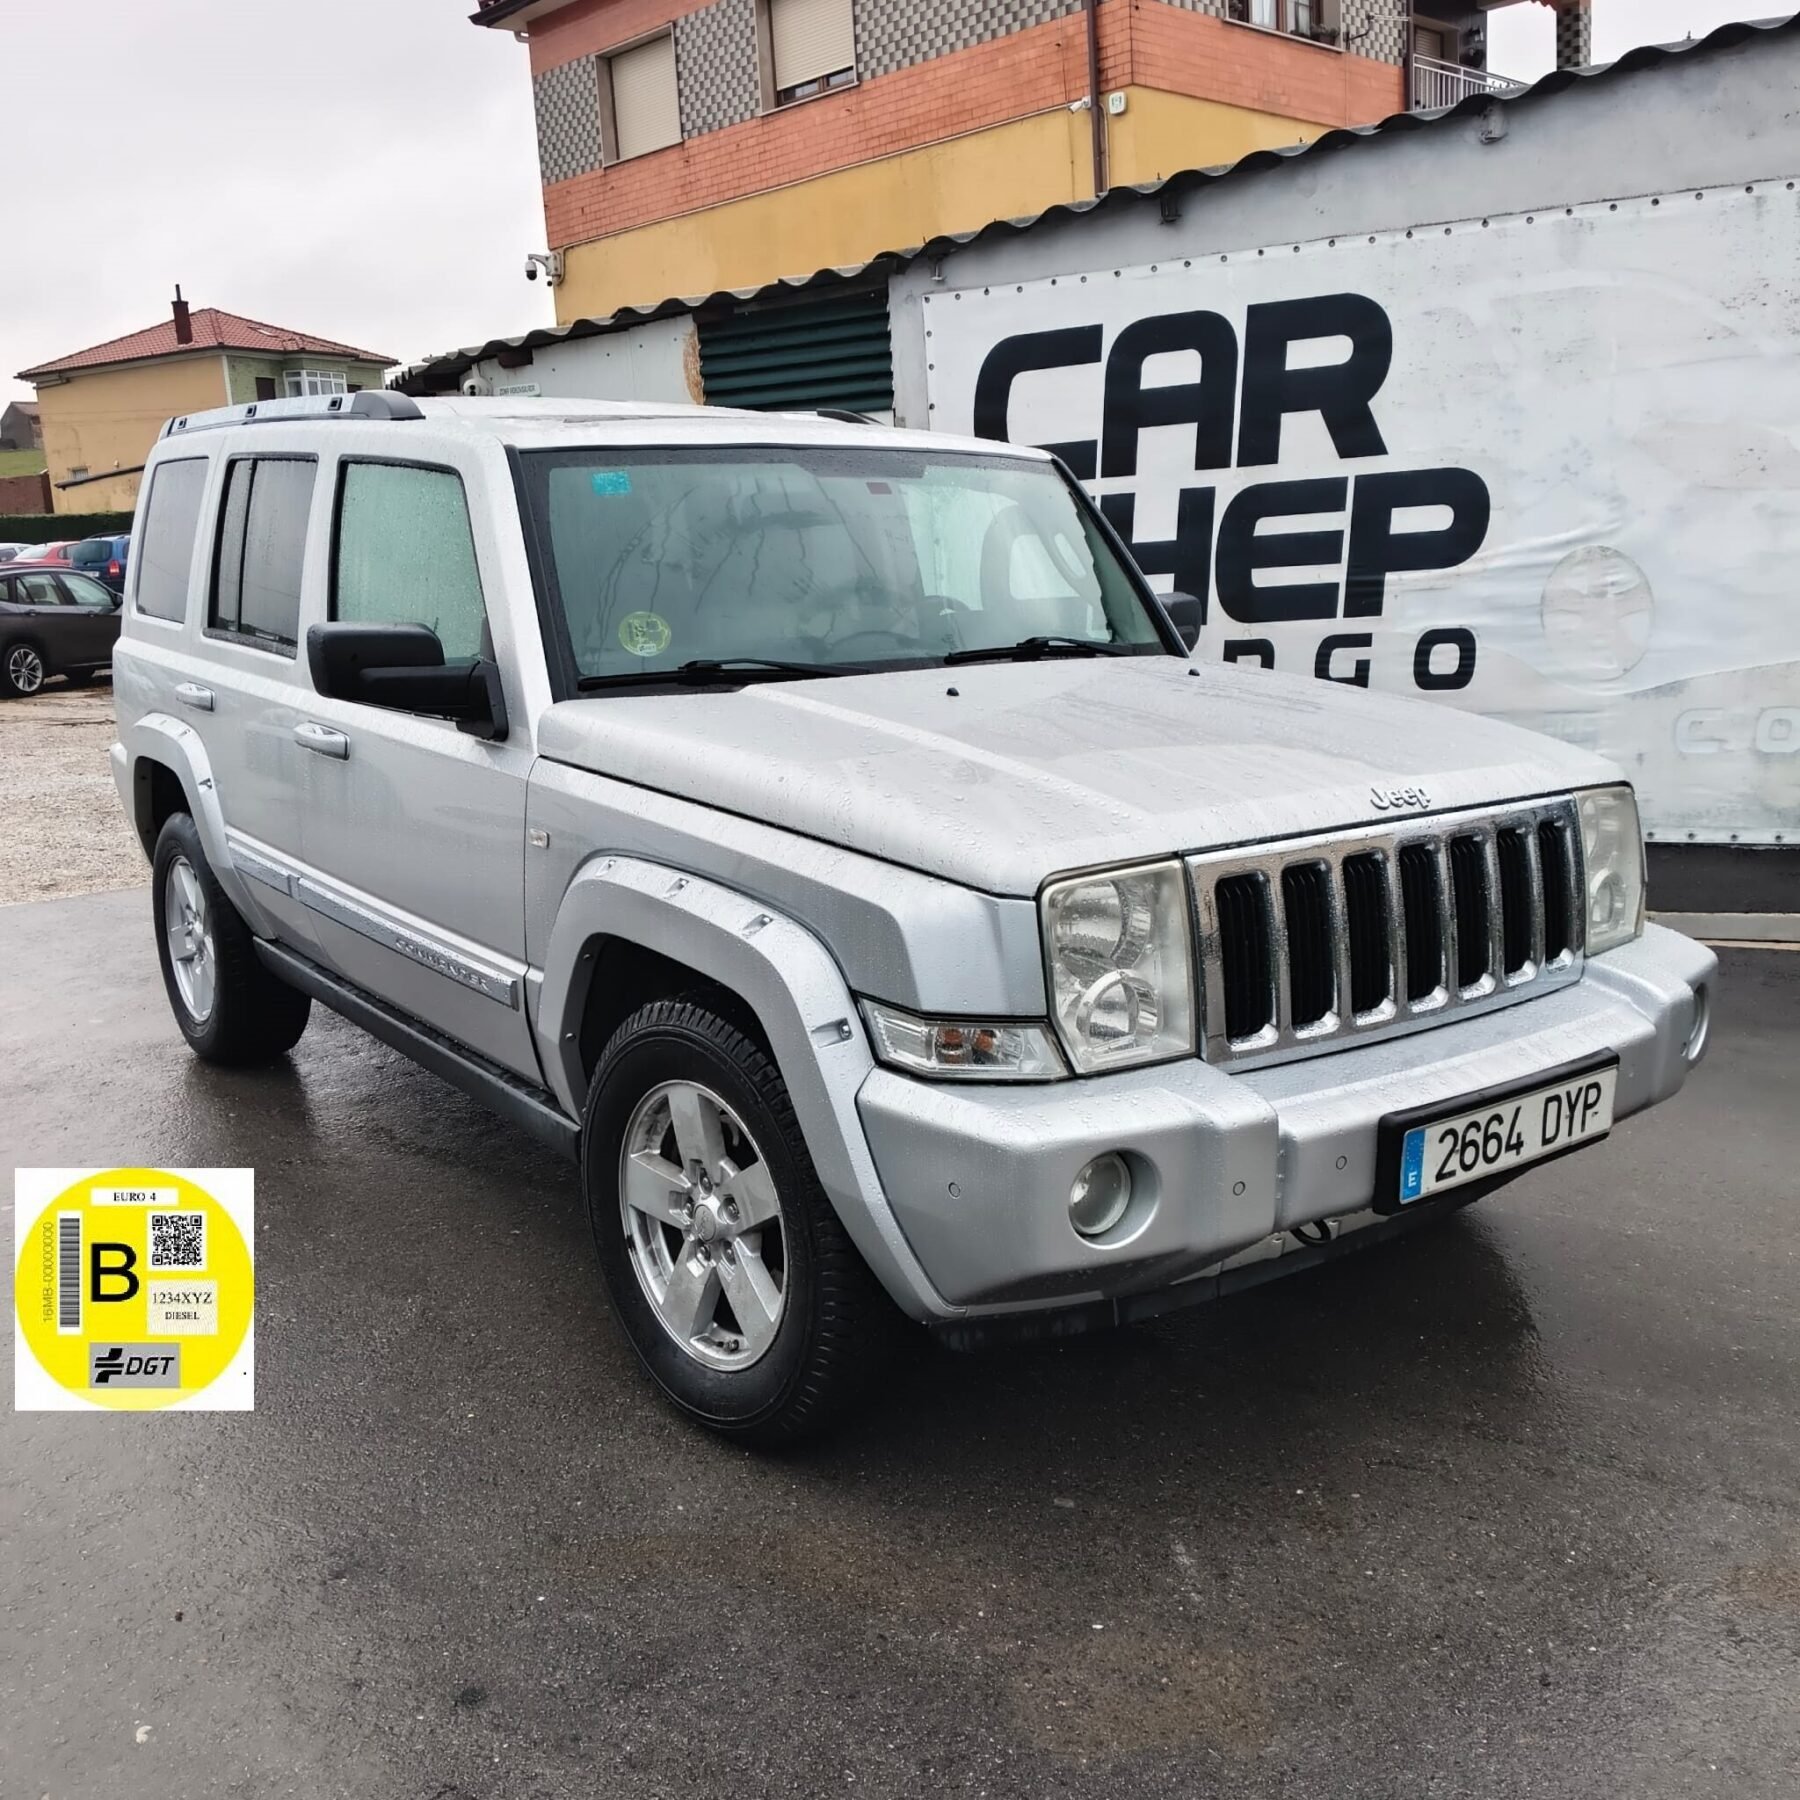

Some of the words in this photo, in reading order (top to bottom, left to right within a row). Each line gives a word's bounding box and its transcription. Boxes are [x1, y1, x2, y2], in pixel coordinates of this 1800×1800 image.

[974, 292, 1392, 480] CAR
[1090, 467, 1490, 625] HEP
[1370, 786, 1432, 811] Jeep
[1407, 1171, 1418, 1188] E
[1435, 1105, 1525, 1183] 2664
[1541, 1081, 1602, 1147] DYP
